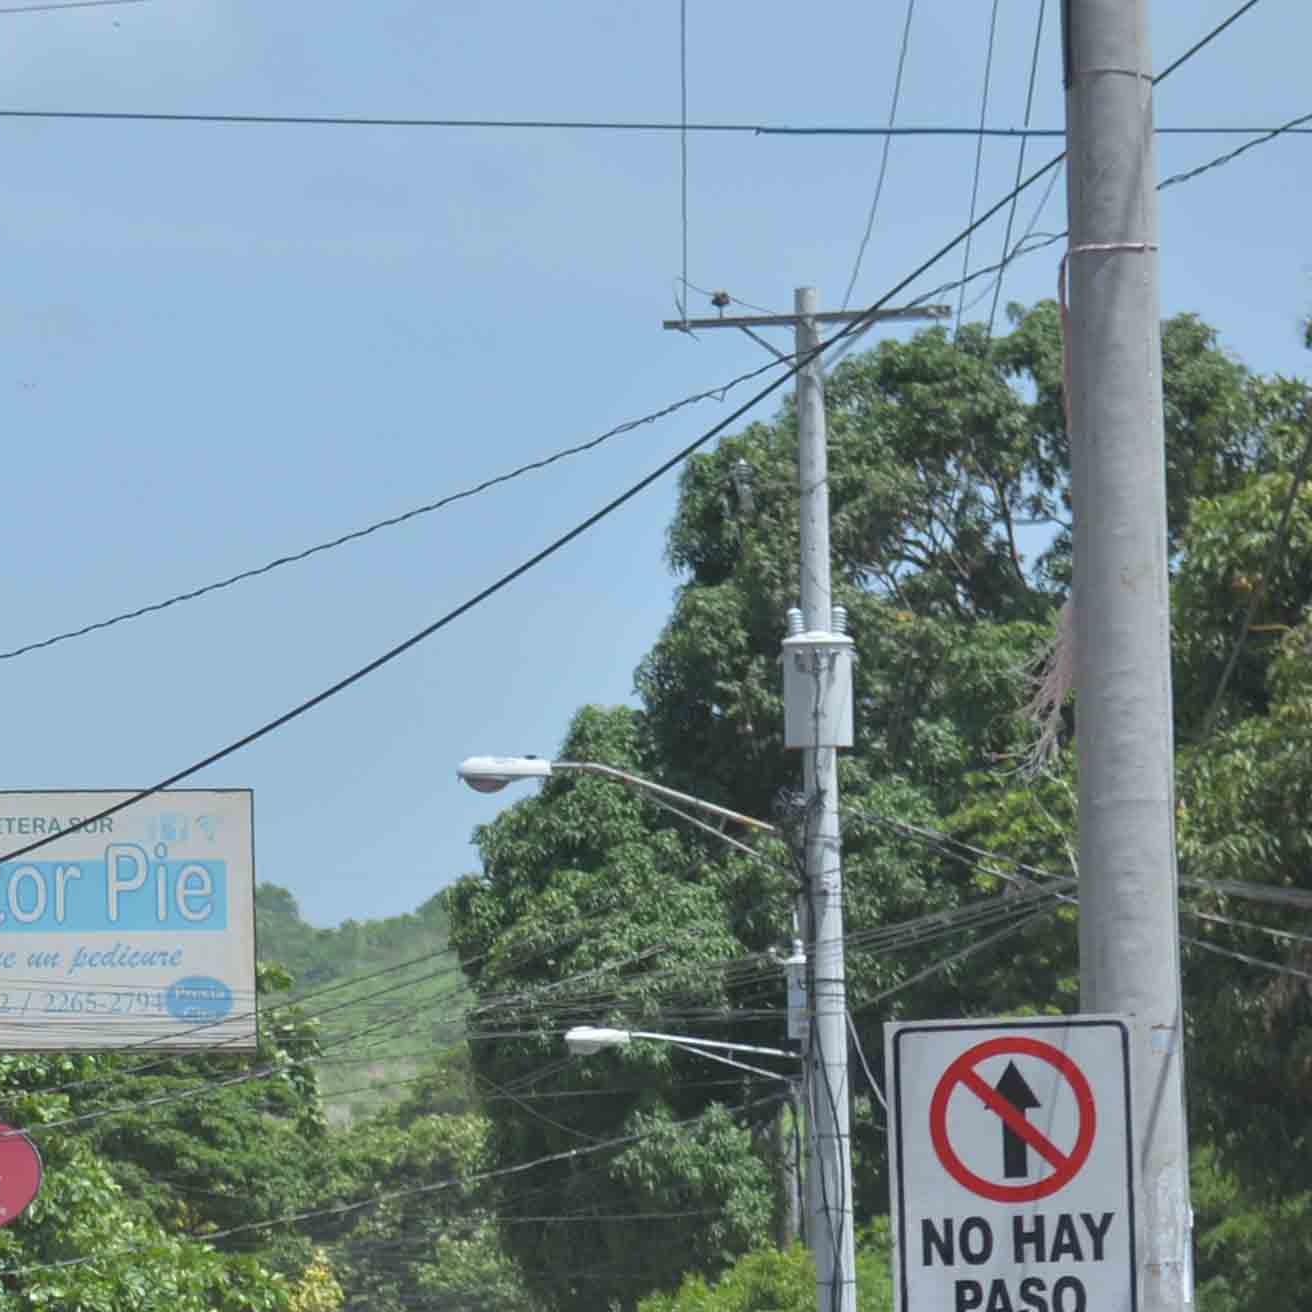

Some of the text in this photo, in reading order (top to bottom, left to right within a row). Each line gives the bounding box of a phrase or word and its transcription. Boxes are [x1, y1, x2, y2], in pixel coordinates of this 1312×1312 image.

[68, 816, 114, 834] SUR
[104, 842, 215, 924] Pie
[26, 951, 61, 968] un
[921, 1212, 1116, 1267] NO HAY
